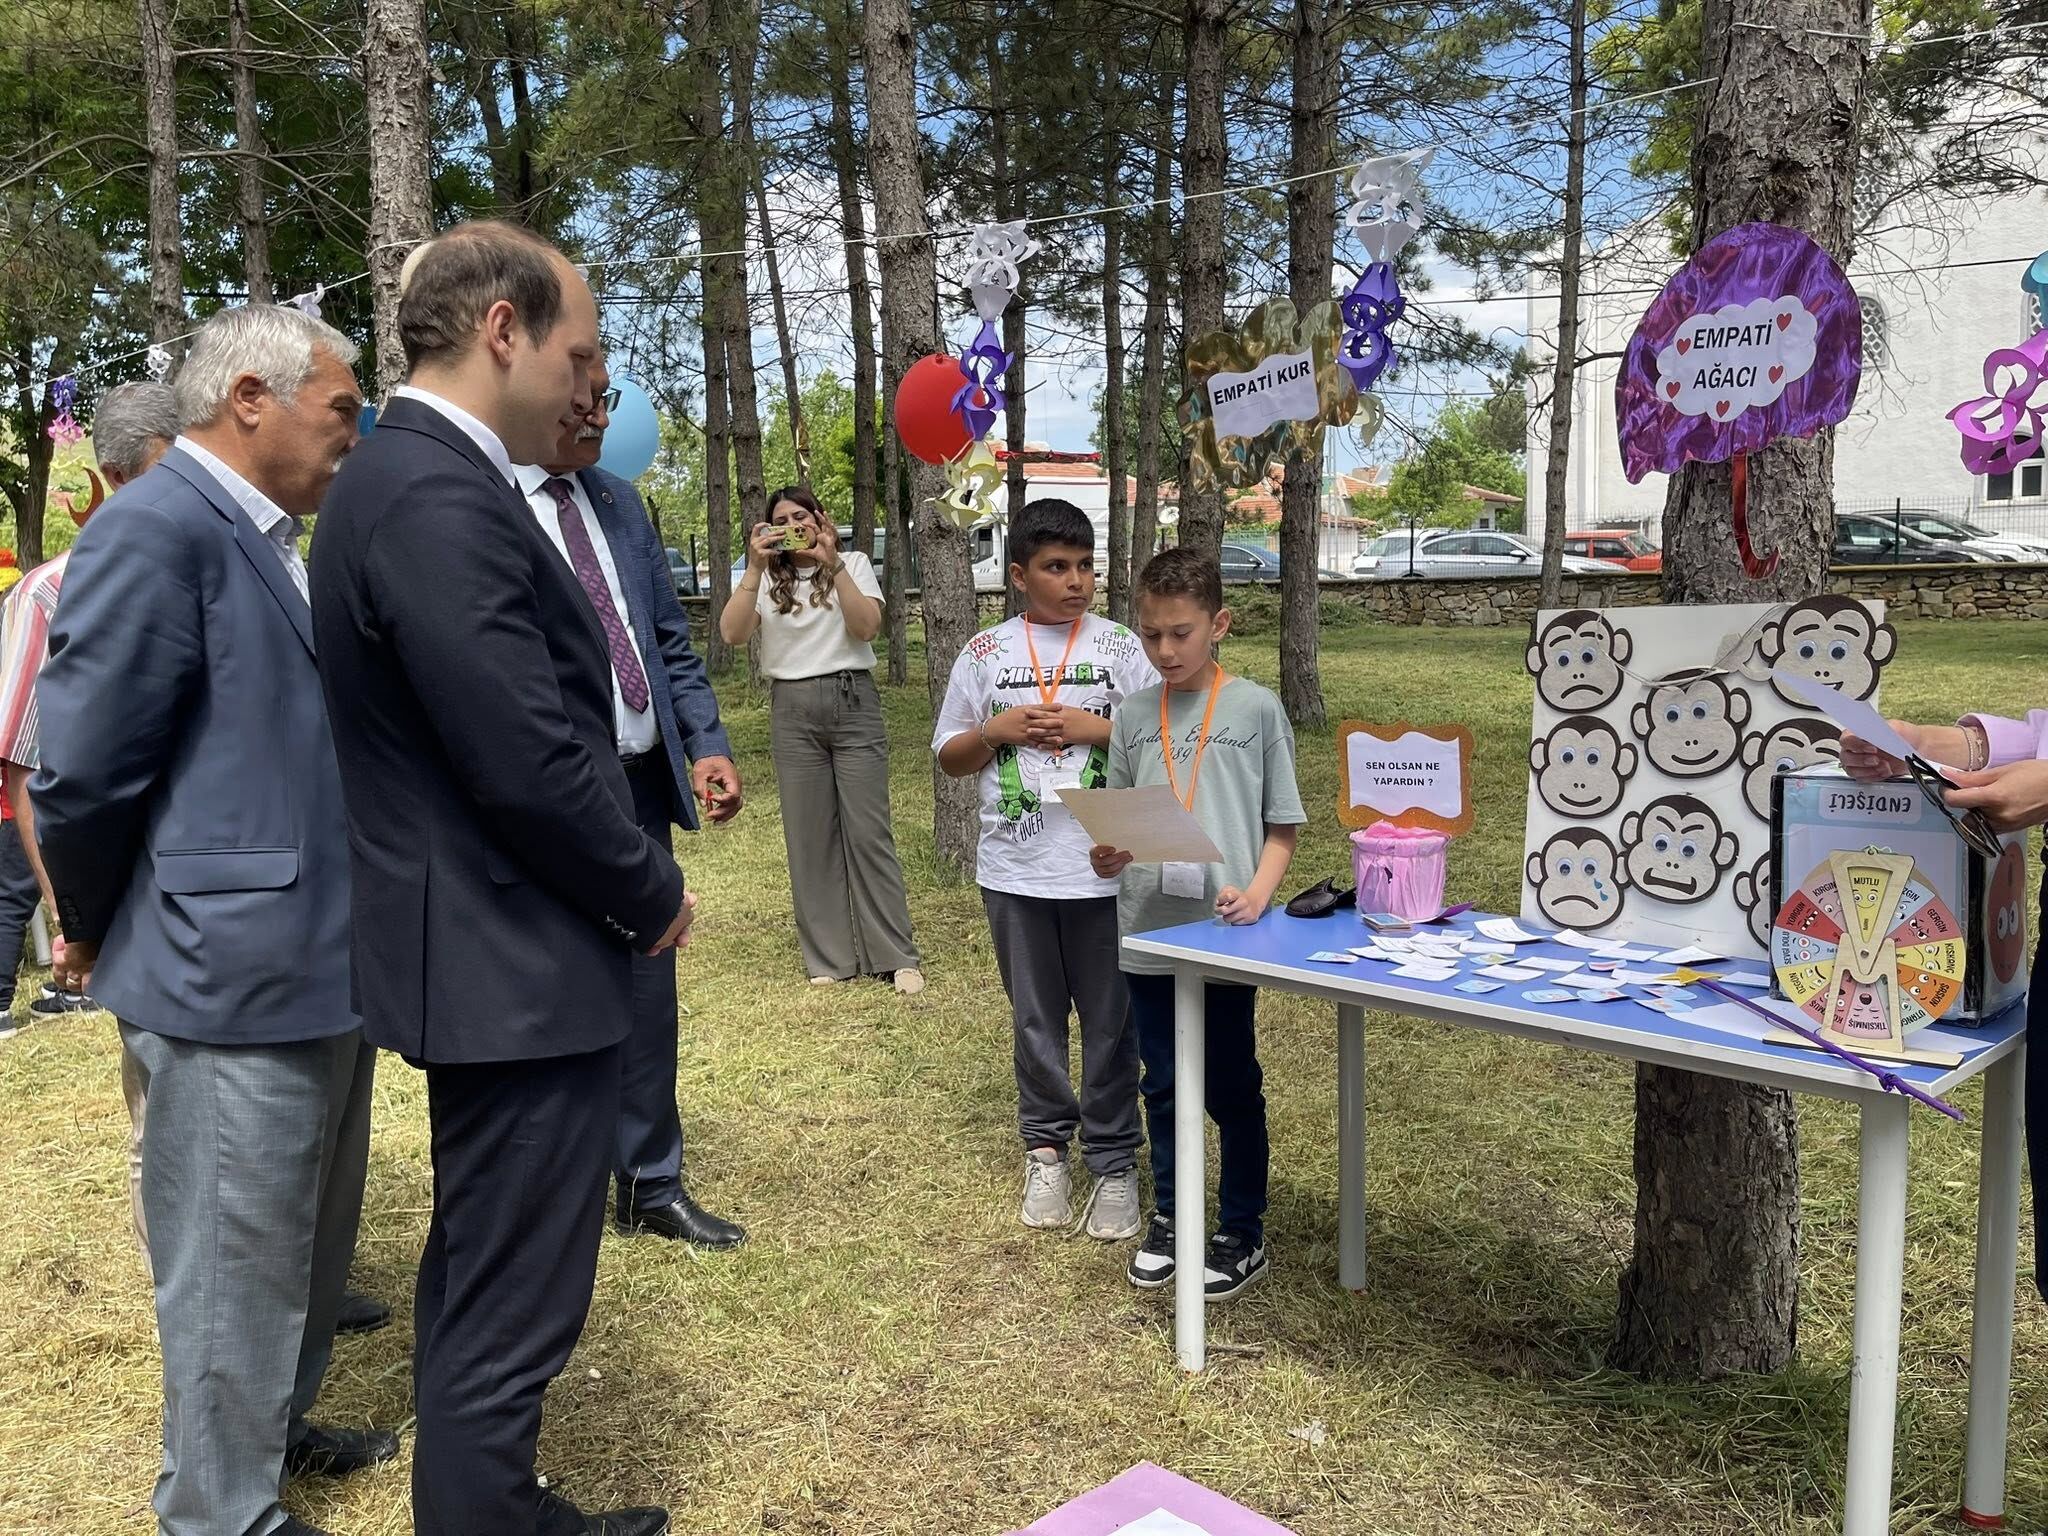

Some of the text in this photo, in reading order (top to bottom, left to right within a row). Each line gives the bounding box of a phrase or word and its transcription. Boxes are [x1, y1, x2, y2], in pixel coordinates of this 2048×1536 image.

[1693, 318, 1773, 350] EMPATİ
[1213, 360, 1311, 406] EMPATİ KUR
[1692, 362, 1758, 390] AĞACI
[971, 638, 993, 654] TNT
[1093, 636, 1139, 657] WITHOUT
[1365, 761, 1441, 771] SEN OLSAN NE
[1373, 777, 1434, 787] YAPARDIN ?
[1828, 791, 1912, 815] ENDİŞELİ
[1020, 810, 1044, 842] OVER
[1812, 881, 1837, 898] KIRGIN
[1853, 876, 1880, 887] MUTLU
[1901, 886, 1920, 902] ZGIN
[1786, 901, 1806, 927] YORGUN
[1926, 908, 1949, 933] GERGİN
[1901, 1009, 1926, 1027] UTANG
